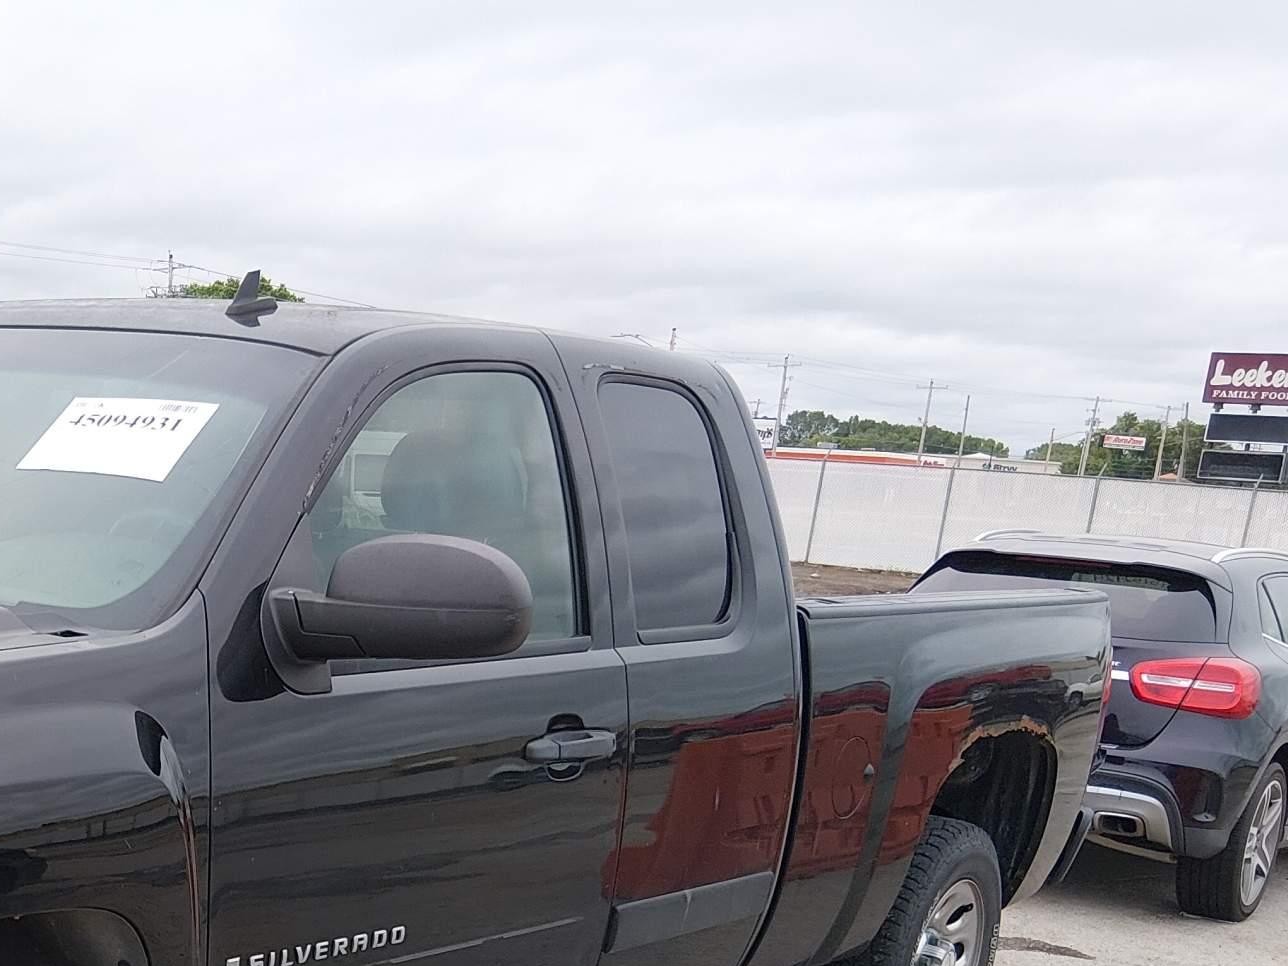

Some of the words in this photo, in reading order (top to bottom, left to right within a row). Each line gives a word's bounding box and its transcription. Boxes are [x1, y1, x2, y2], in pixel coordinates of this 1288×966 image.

[1212, 389, 1259, 399] FAMILY
[1260, 391, 1288, 400] FOO
[69, 414, 183, 431] 45094931
